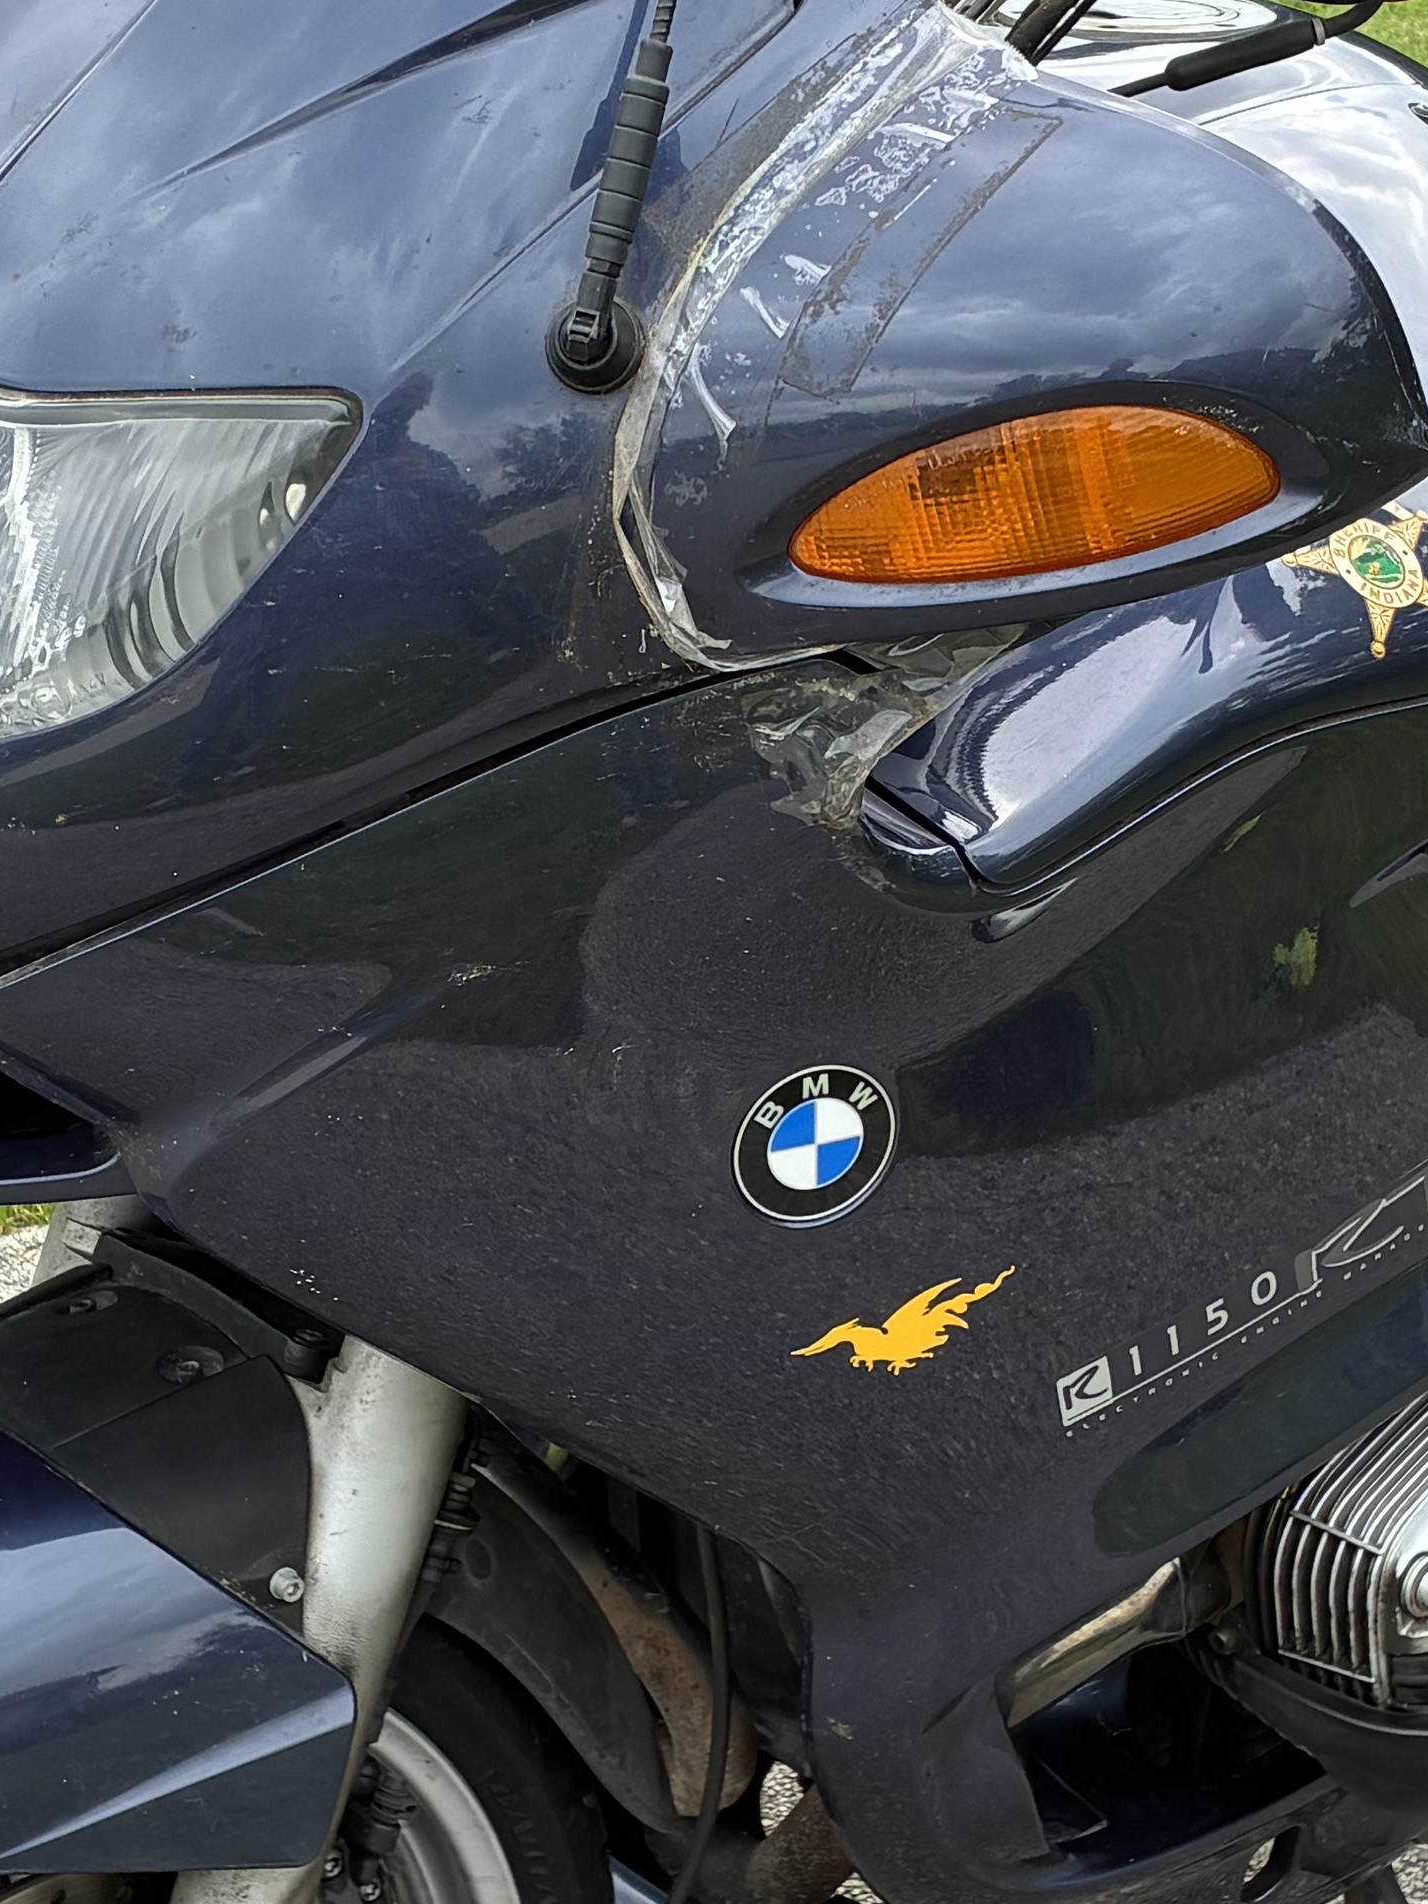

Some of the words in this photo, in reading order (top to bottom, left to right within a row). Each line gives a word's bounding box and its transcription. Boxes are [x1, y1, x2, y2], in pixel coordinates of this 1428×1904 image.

[1335, 519, 1396, 559] SHERIFF
[1360, 569, 1420, 605] INDIANA
[754, 1073, 878, 1129] BMW
